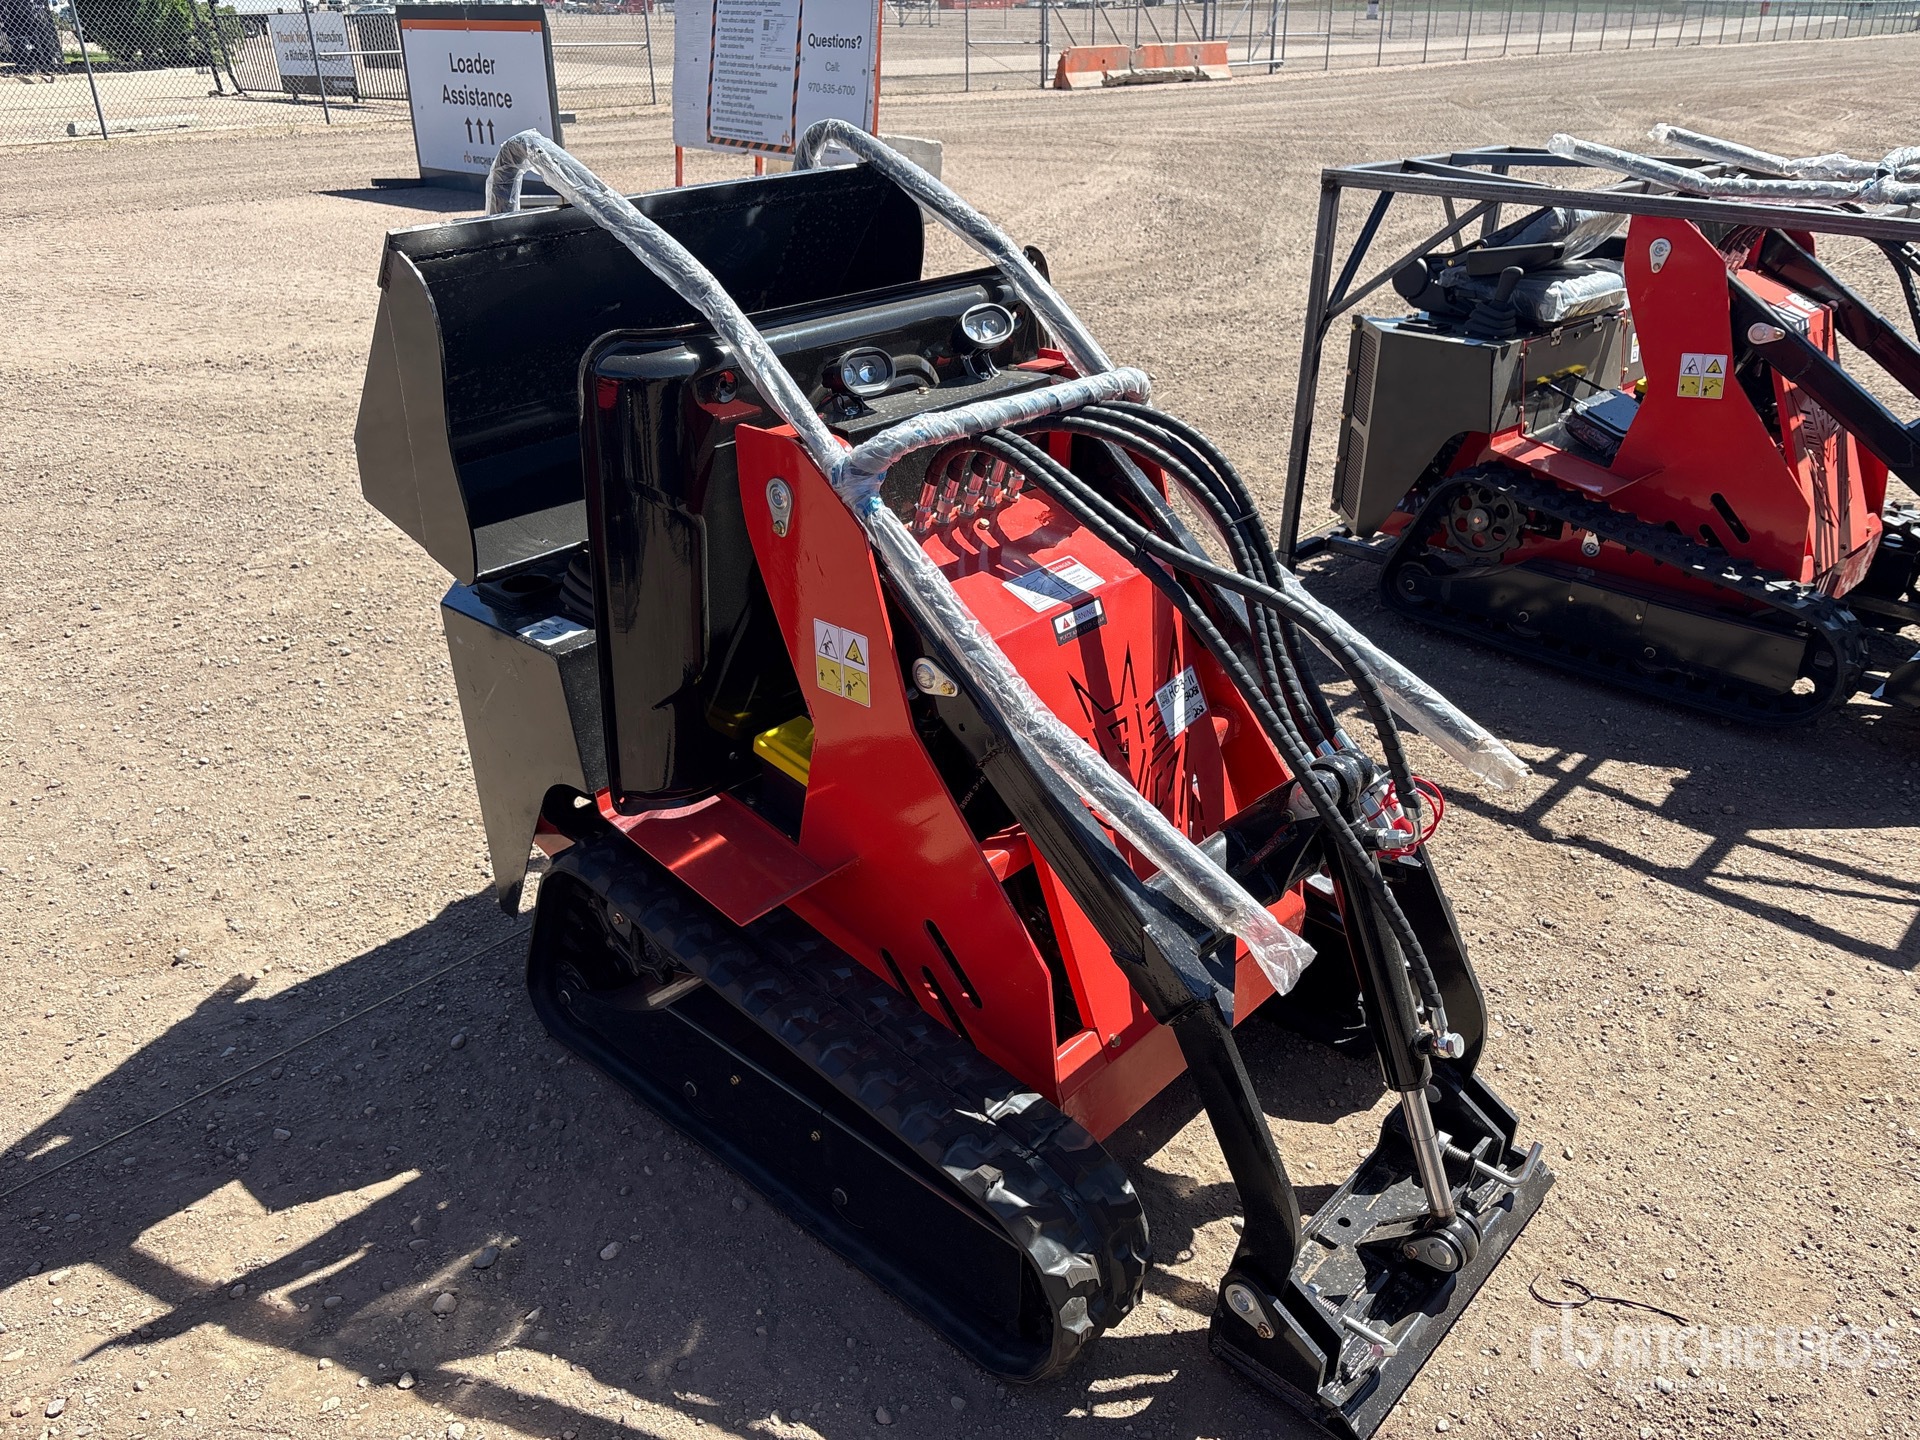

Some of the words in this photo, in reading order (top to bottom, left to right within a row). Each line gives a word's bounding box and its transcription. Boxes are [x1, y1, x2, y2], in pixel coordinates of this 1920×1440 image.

[316, 31, 344, 46] Attending
[808, 33, 862, 50] Questions?
[449, 52, 495, 75] Loader
[442, 84, 512, 109] Assistance
[808, 82, 856, 96] 970-535-6700
[1052, 560, 1072, 572] DANGER
[1069, 606, 1096, 624] WARNING
